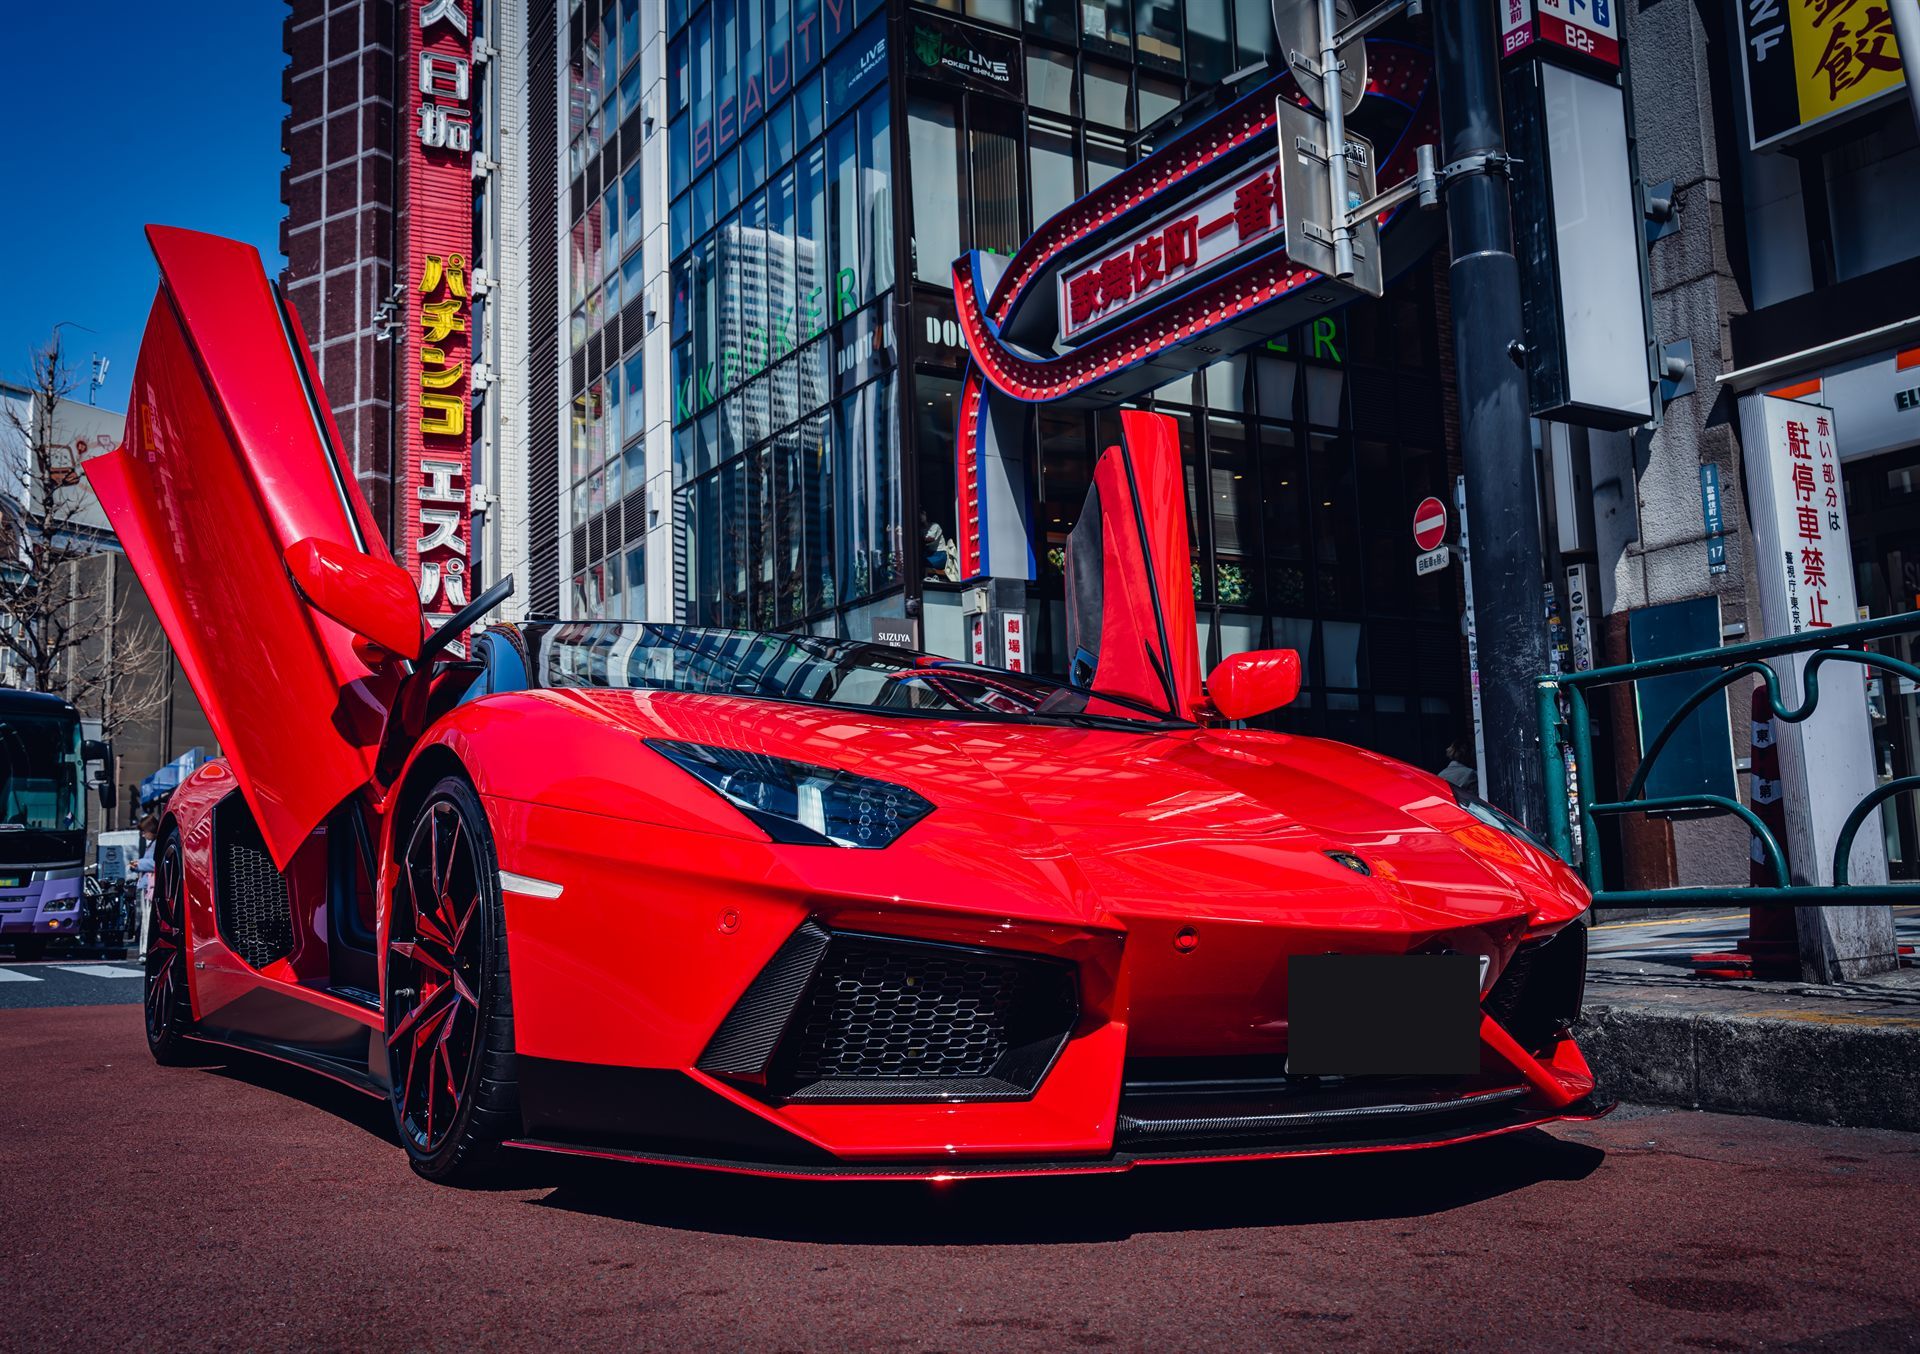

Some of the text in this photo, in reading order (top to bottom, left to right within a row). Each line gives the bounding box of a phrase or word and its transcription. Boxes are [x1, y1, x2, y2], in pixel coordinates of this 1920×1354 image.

[694, 0, 845, 168] BEAUTY
[1506, 31, 1530, 52] B2F
[1565, 24, 1595, 53] B2F
[1803, 0, 1904, 101] 餃
[418, 253, 466, 436] パチンコ
[1786, 420, 1832, 628] 駐停車禁止
[1816, 416, 1841, 531] 赤い部分は
[1711, 546, 1723, 558] 17
[878, 632, 911, 642] SUZUYA
